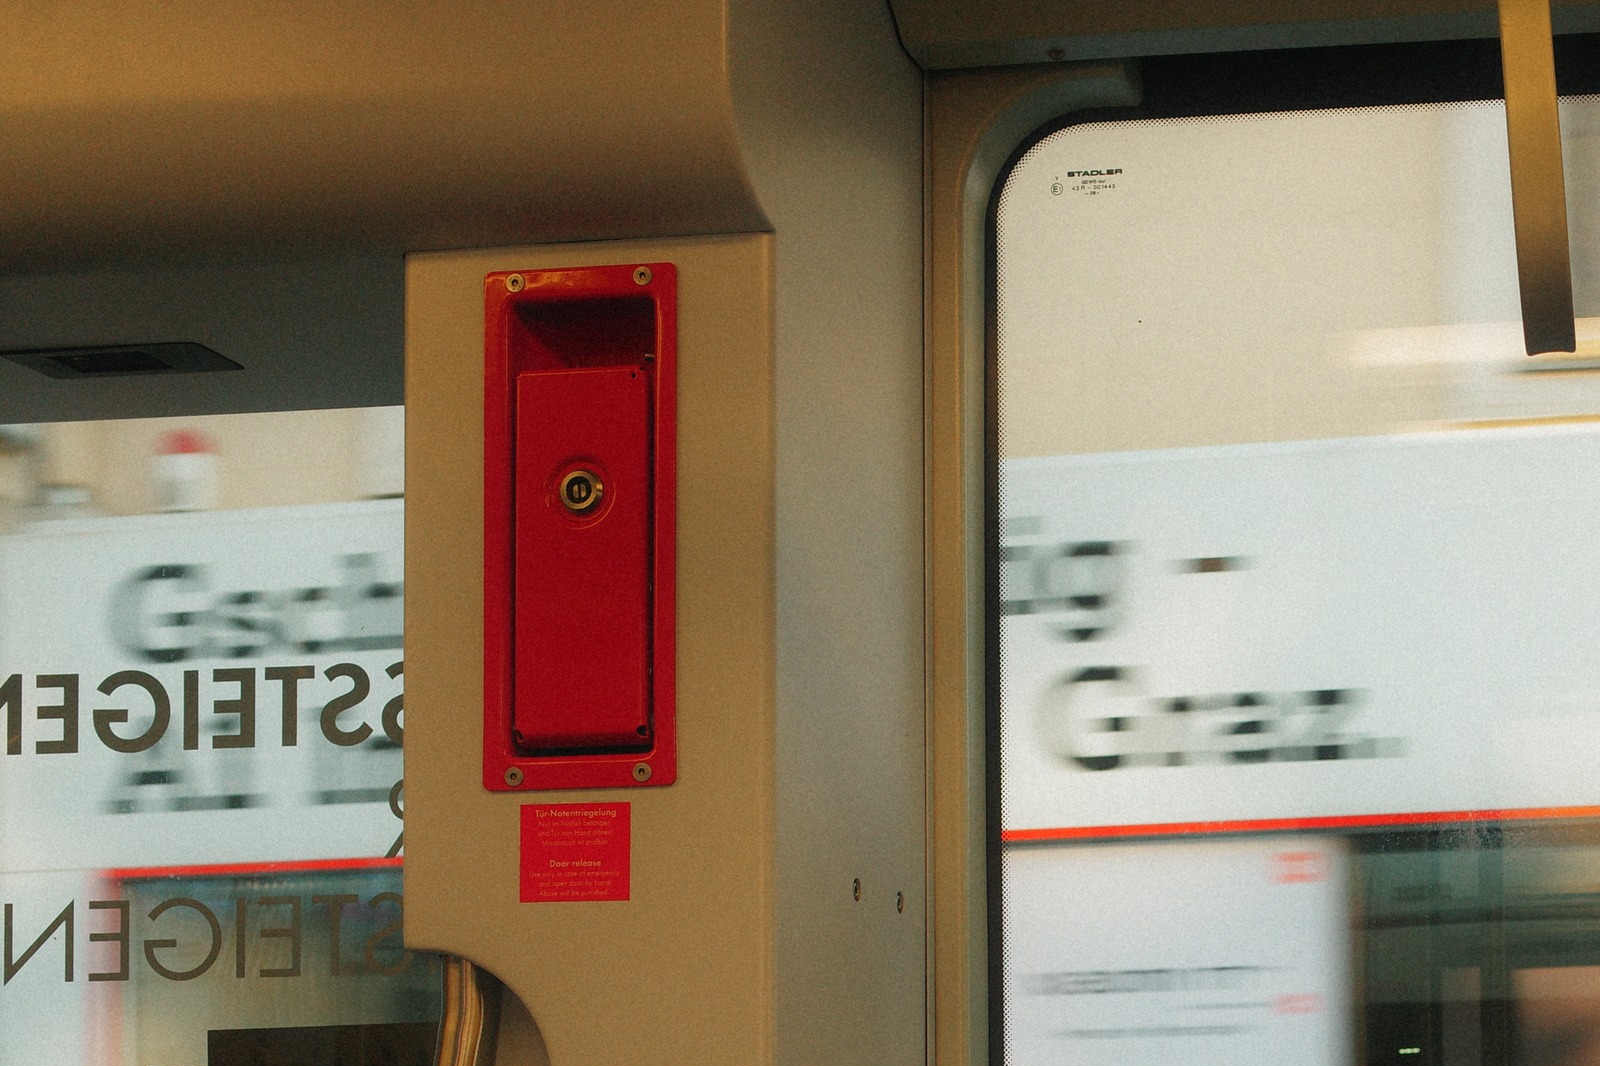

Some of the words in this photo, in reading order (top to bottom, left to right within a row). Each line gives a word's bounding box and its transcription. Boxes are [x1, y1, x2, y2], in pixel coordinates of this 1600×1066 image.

[1067, 168, 1122, 177] STADLER
[535, 808, 617, 818] Tür-Notentriegelung
[549, 859, 570, 868] Door
[572, 858, 602, 867] release
[542, 870, 555, 878] only
[586, 870, 620, 879] emergency
[538, 880, 551, 888] and
[552, 880, 568, 889] open
[569, 879, 584, 887] door
[594, 878, 612, 887] hand!
[539, 889, 558, 897] Abuse
